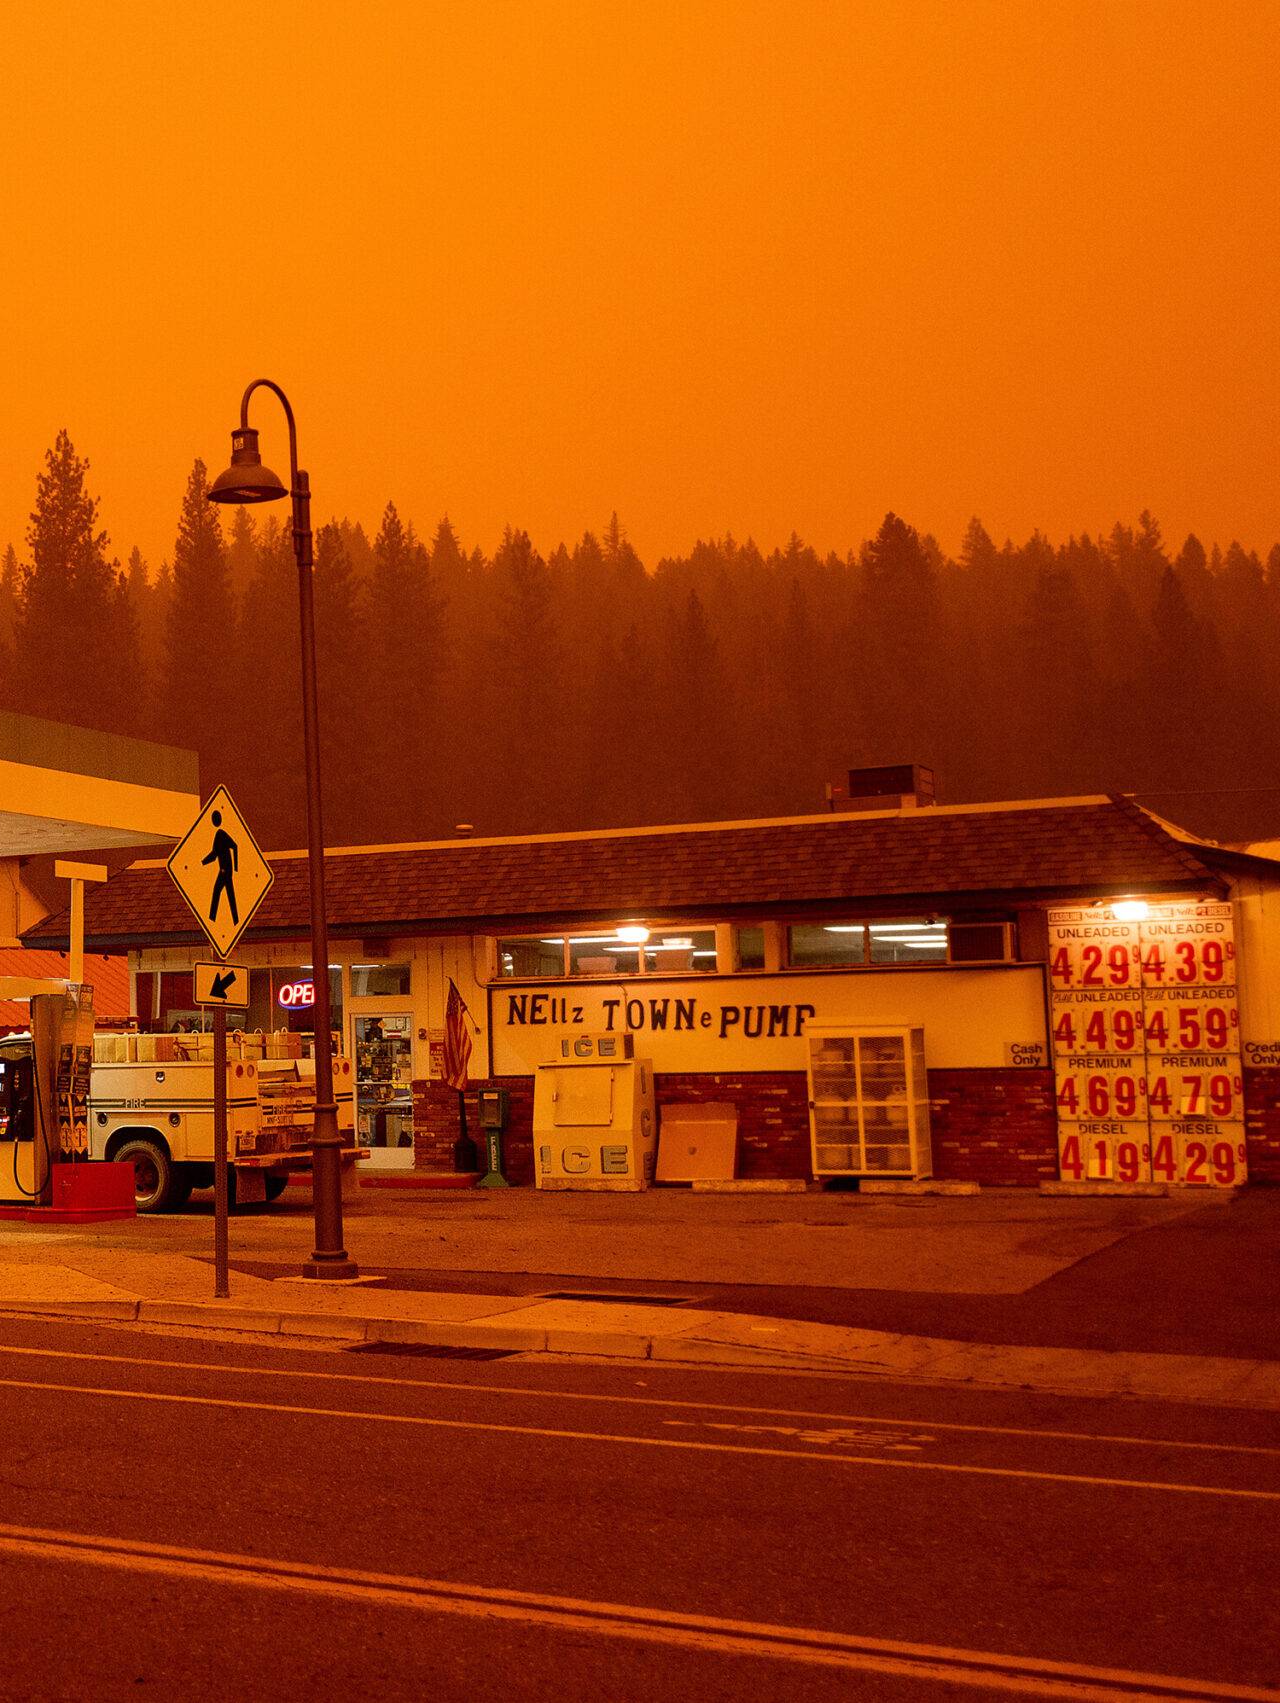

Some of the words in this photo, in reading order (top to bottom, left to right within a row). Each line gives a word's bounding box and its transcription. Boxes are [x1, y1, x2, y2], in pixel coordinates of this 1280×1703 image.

[1057, 926, 1130, 939] UNLEADED
[1148, 922, 1224, 935] UNLEADED
[1076, 992, 1140, 1003] UNLEADED
[1168, 989, 1235, 1001] UNLEADED
[562, 1037, 616, 1057] ICE
[1011, 1043, 1042, 1054] Cash
[1013, 1055, 1041, 1066] Only
[1069, 1058, 1131, 1069] PREMIUM
[1161, 1057, 1227, 1068] PREMIUM
[125, 1098, 146, 1109] FIRE
[1079, 1124, 1127, 1134] DIESEL
[1172, 1123, 1222, 1134] DIESEL
[540, 1145, 628, 1174] ICE
